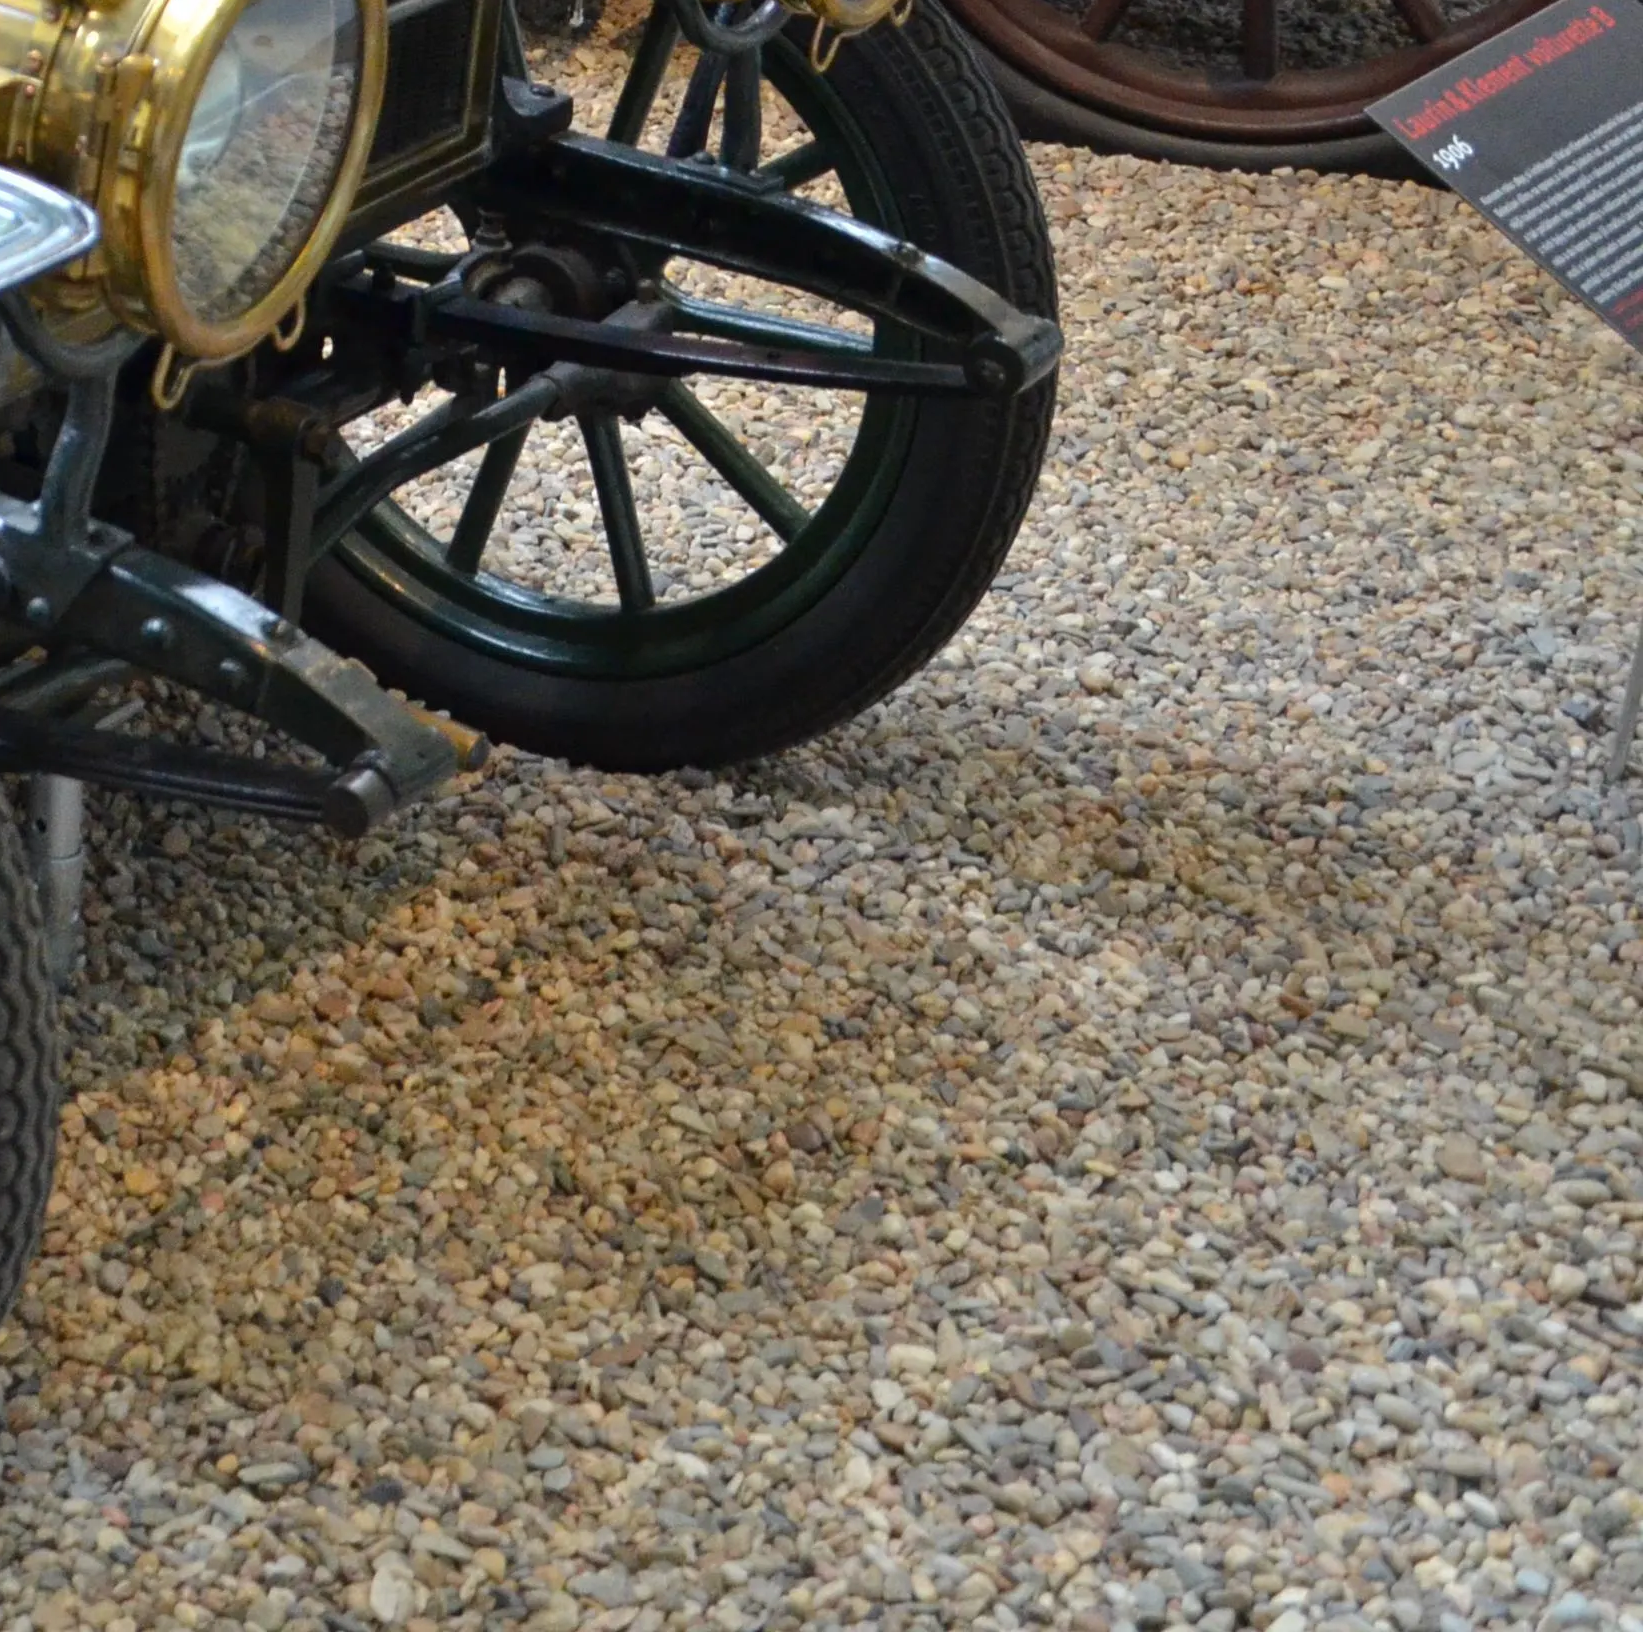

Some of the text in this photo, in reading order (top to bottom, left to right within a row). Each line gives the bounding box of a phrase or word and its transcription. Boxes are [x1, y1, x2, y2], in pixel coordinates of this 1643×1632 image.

[1392, 99, 1456, 139] Laurin
[1455, 53, 1534, 104] Klement
[1432, 134, 1474, 170] 1906
